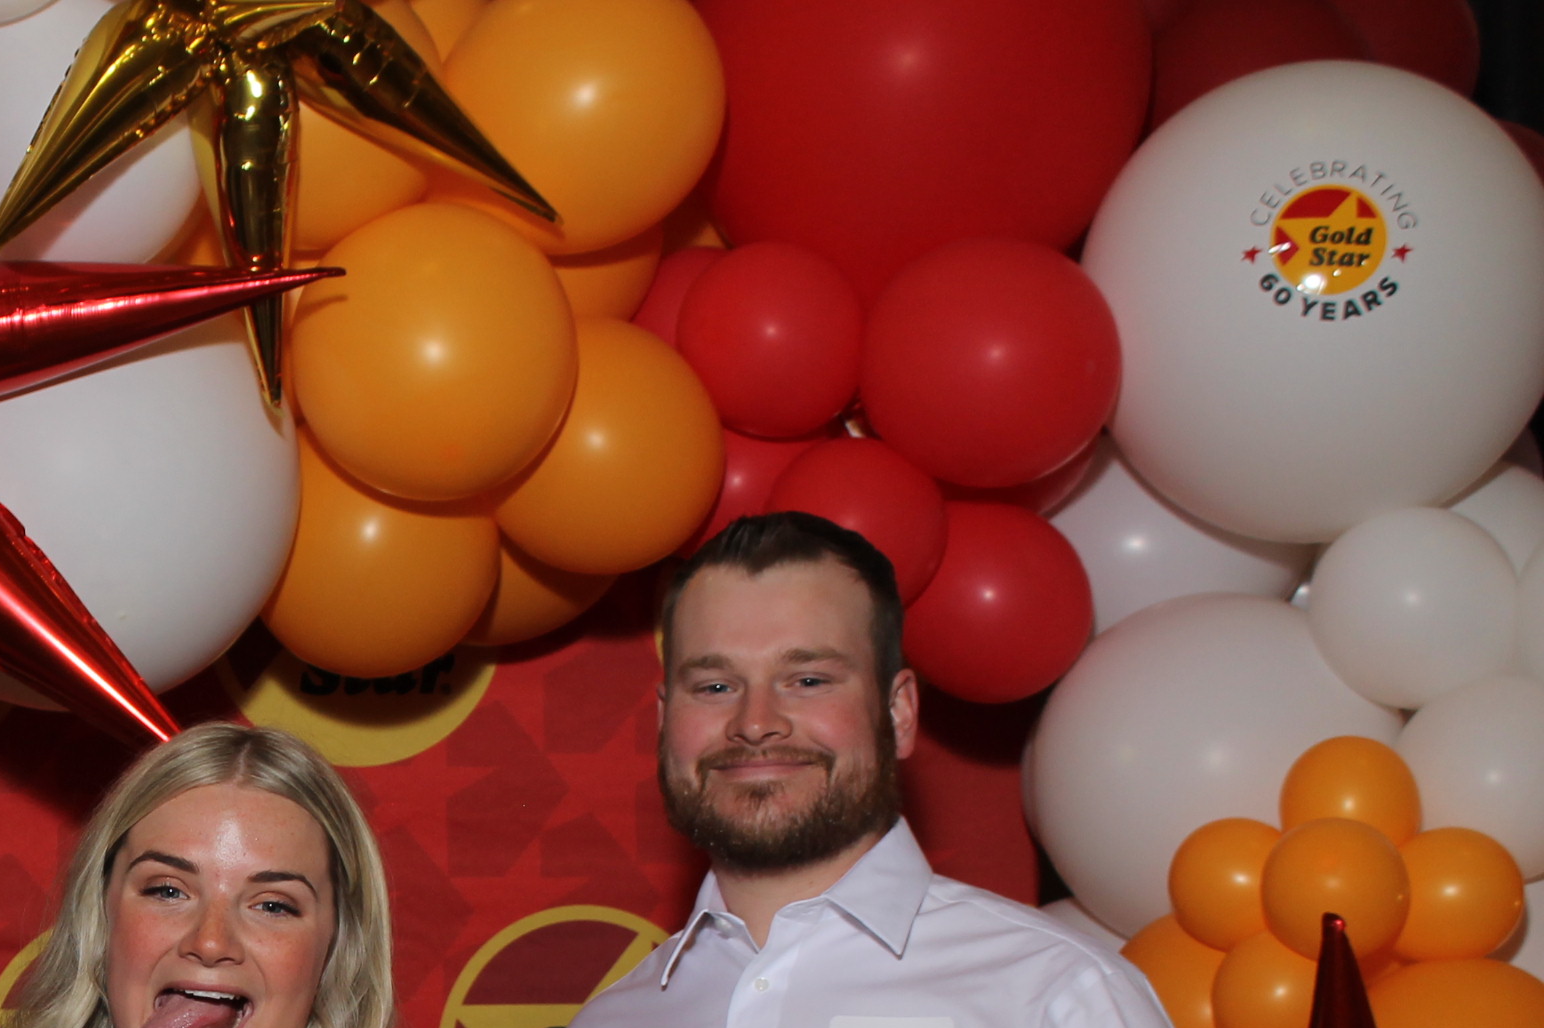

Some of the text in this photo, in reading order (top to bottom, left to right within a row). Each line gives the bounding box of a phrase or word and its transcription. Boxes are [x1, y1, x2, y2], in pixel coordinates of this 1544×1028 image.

[1250, 160, 1419, 230] CELEBRATING
[1309, 225, 1374, 246] Gold
[1309, 247, 1370, 268] Star
[1259, 273, 1399, 322] 60 YEARS
